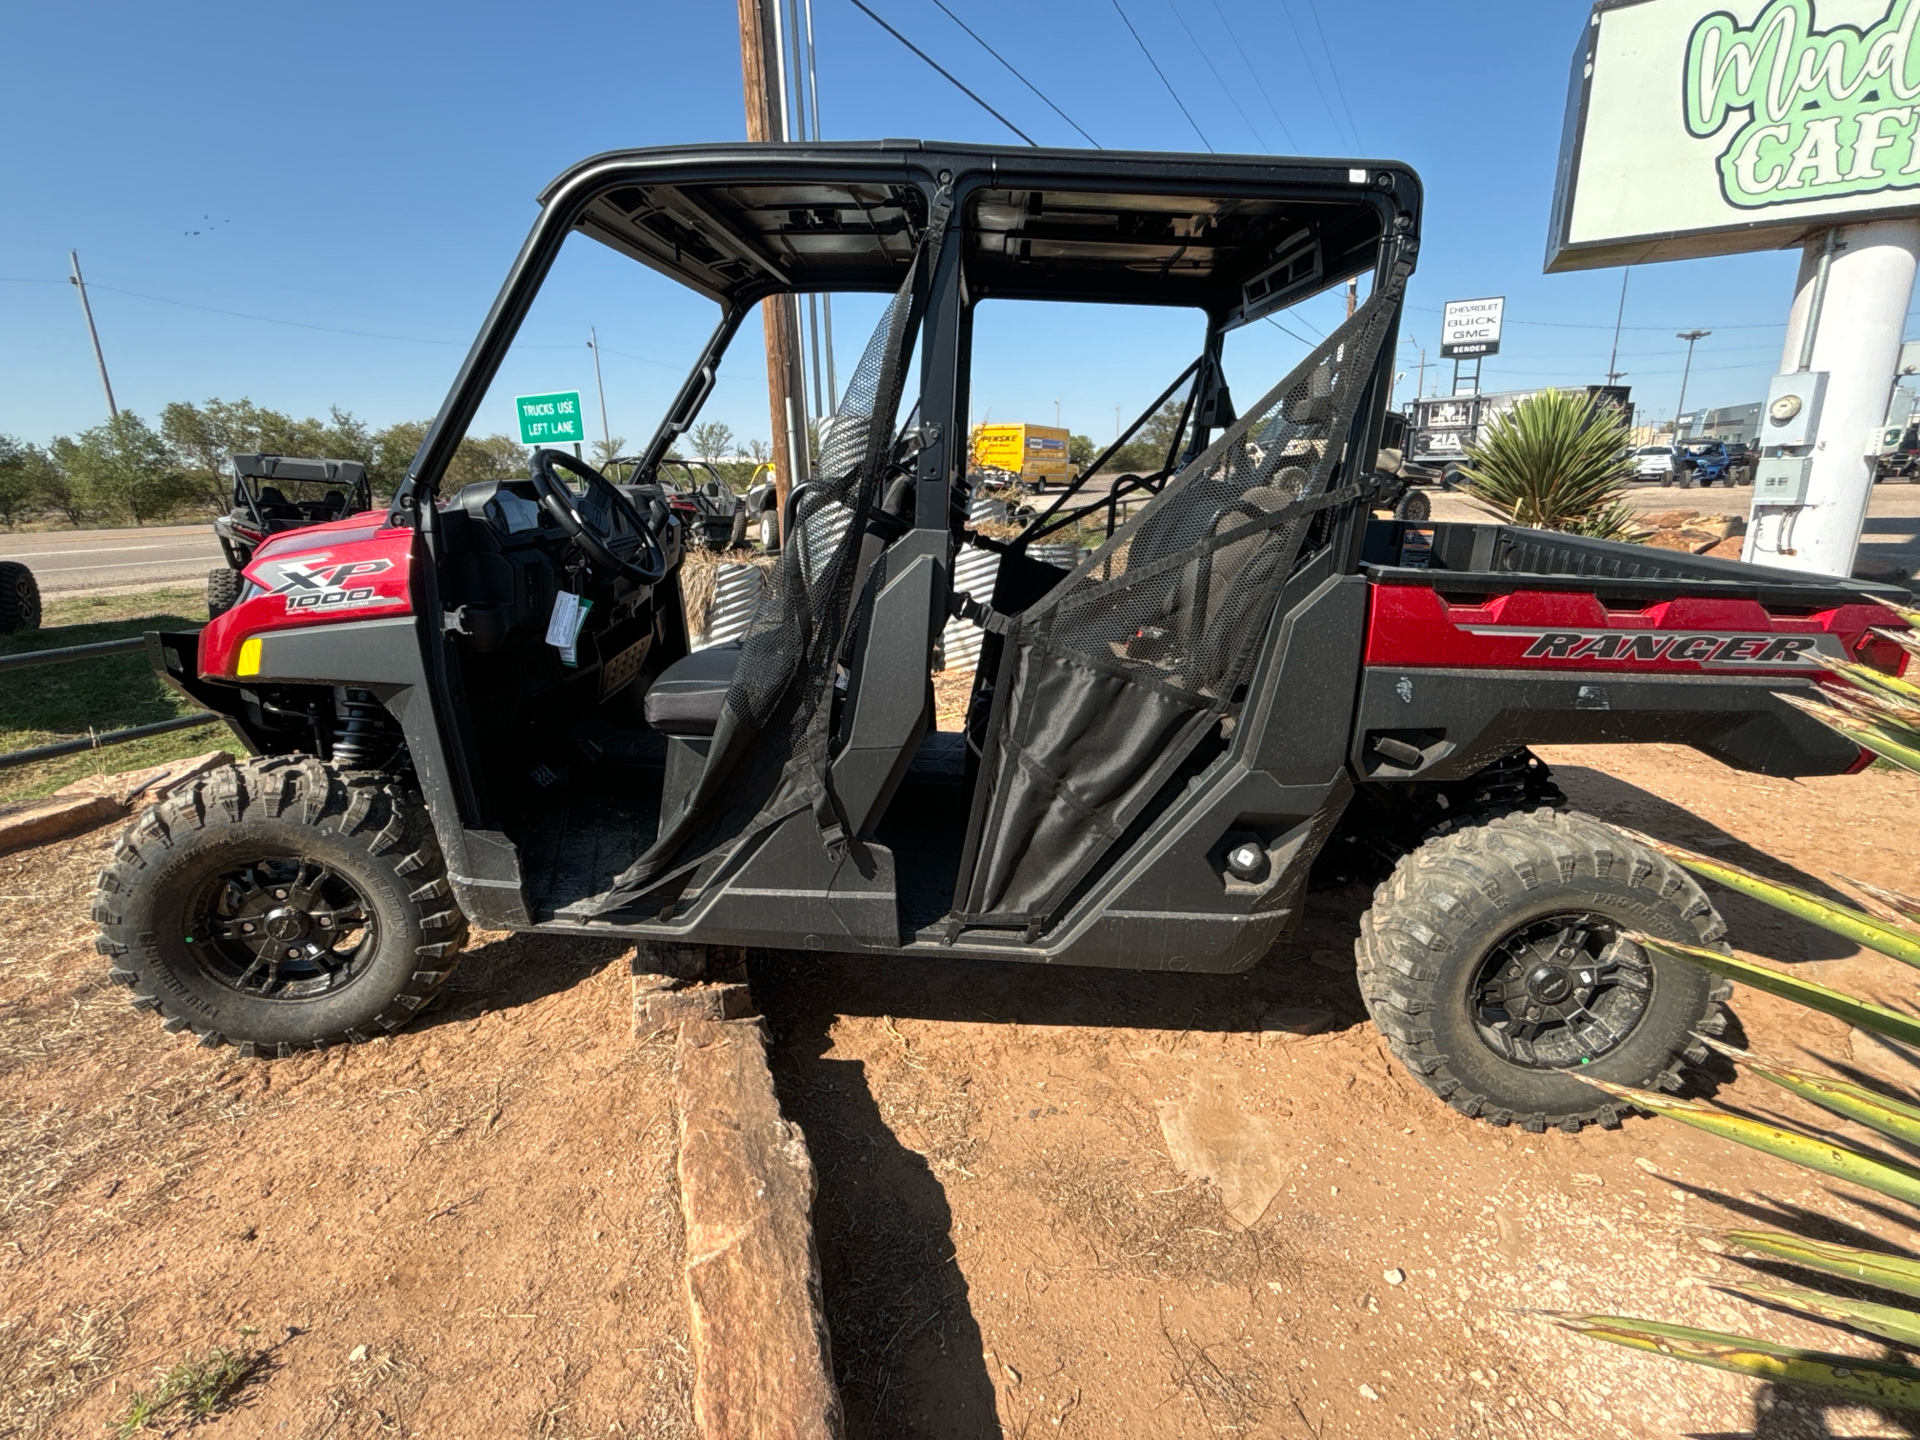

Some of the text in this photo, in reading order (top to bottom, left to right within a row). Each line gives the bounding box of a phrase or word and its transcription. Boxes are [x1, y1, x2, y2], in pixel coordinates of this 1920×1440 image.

[1449, 303, 1498, 314] CHEVROLET
[1447, 316, 1497, 327] BUICK
[1453, 329, 1490, 339] GMC
[1453, 344, 1487, 354] BENDER
[522, 401, 575, 417] TRUCKS USE
[528, 420, 575, 436] LEFT LANE
[980, 434, 1018, 443] PENSKE
[1430, 433, 1461, 446] ZIA
[262, 558, 395, 598] XP
[285, 586, 375, 611] 1000
[1522, 632, 1817, 662] RANGER
